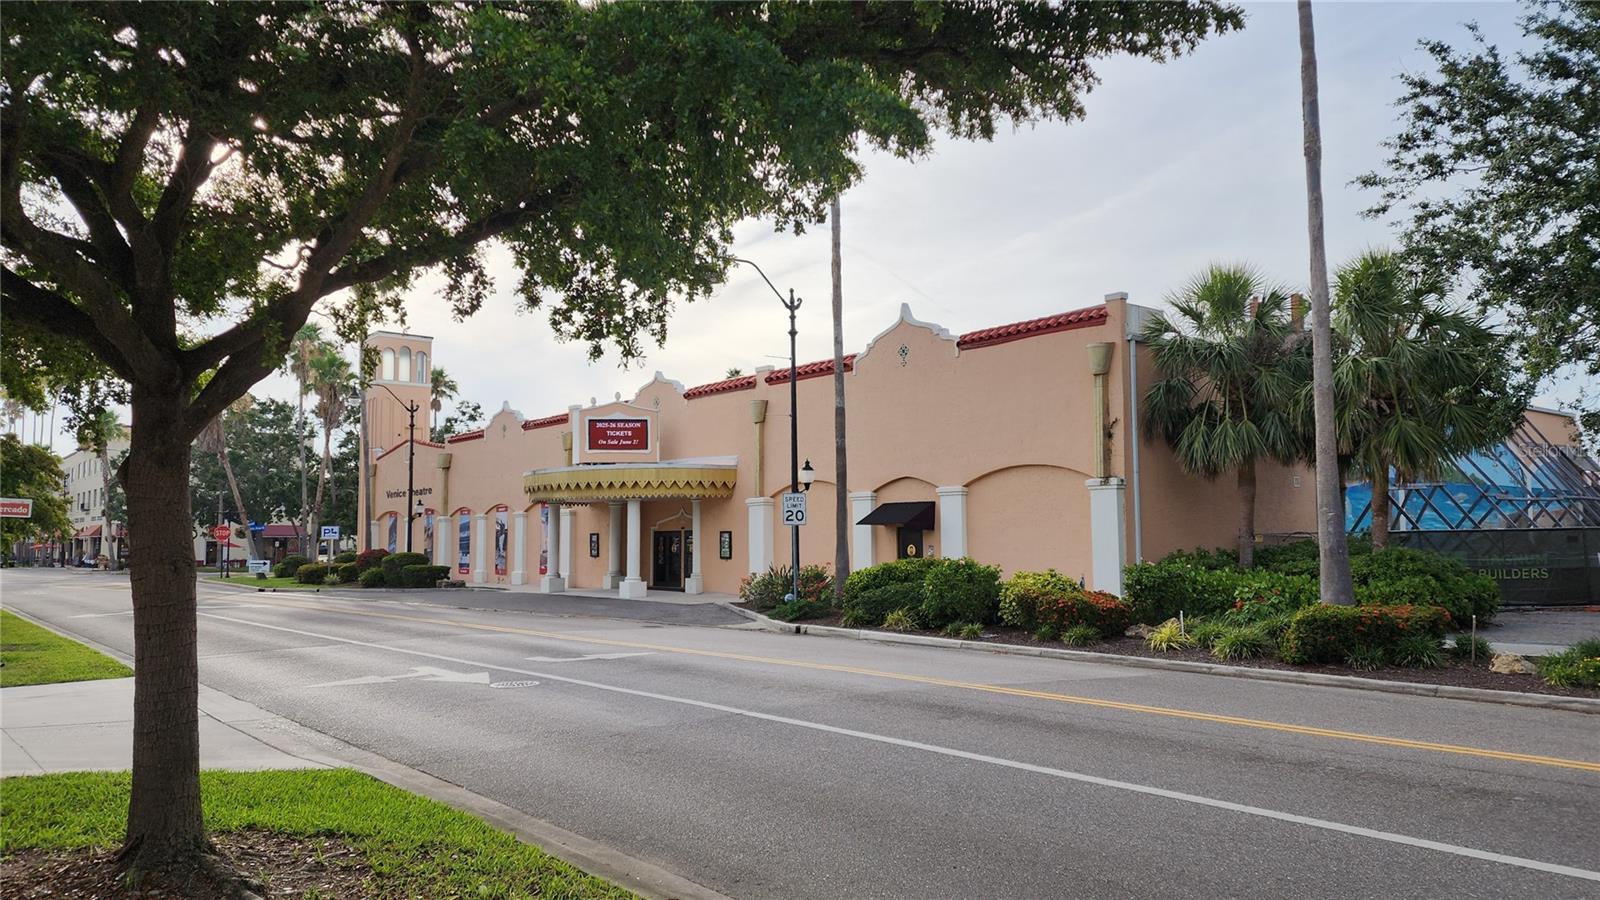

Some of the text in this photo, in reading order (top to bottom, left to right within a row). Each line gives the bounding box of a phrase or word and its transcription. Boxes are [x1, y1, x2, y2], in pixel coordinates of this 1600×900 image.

[385, 489, 407, 499] Venice
[785, 510, 804, 521] 20
[1479, 568, 1550, 580] BUILDERS
